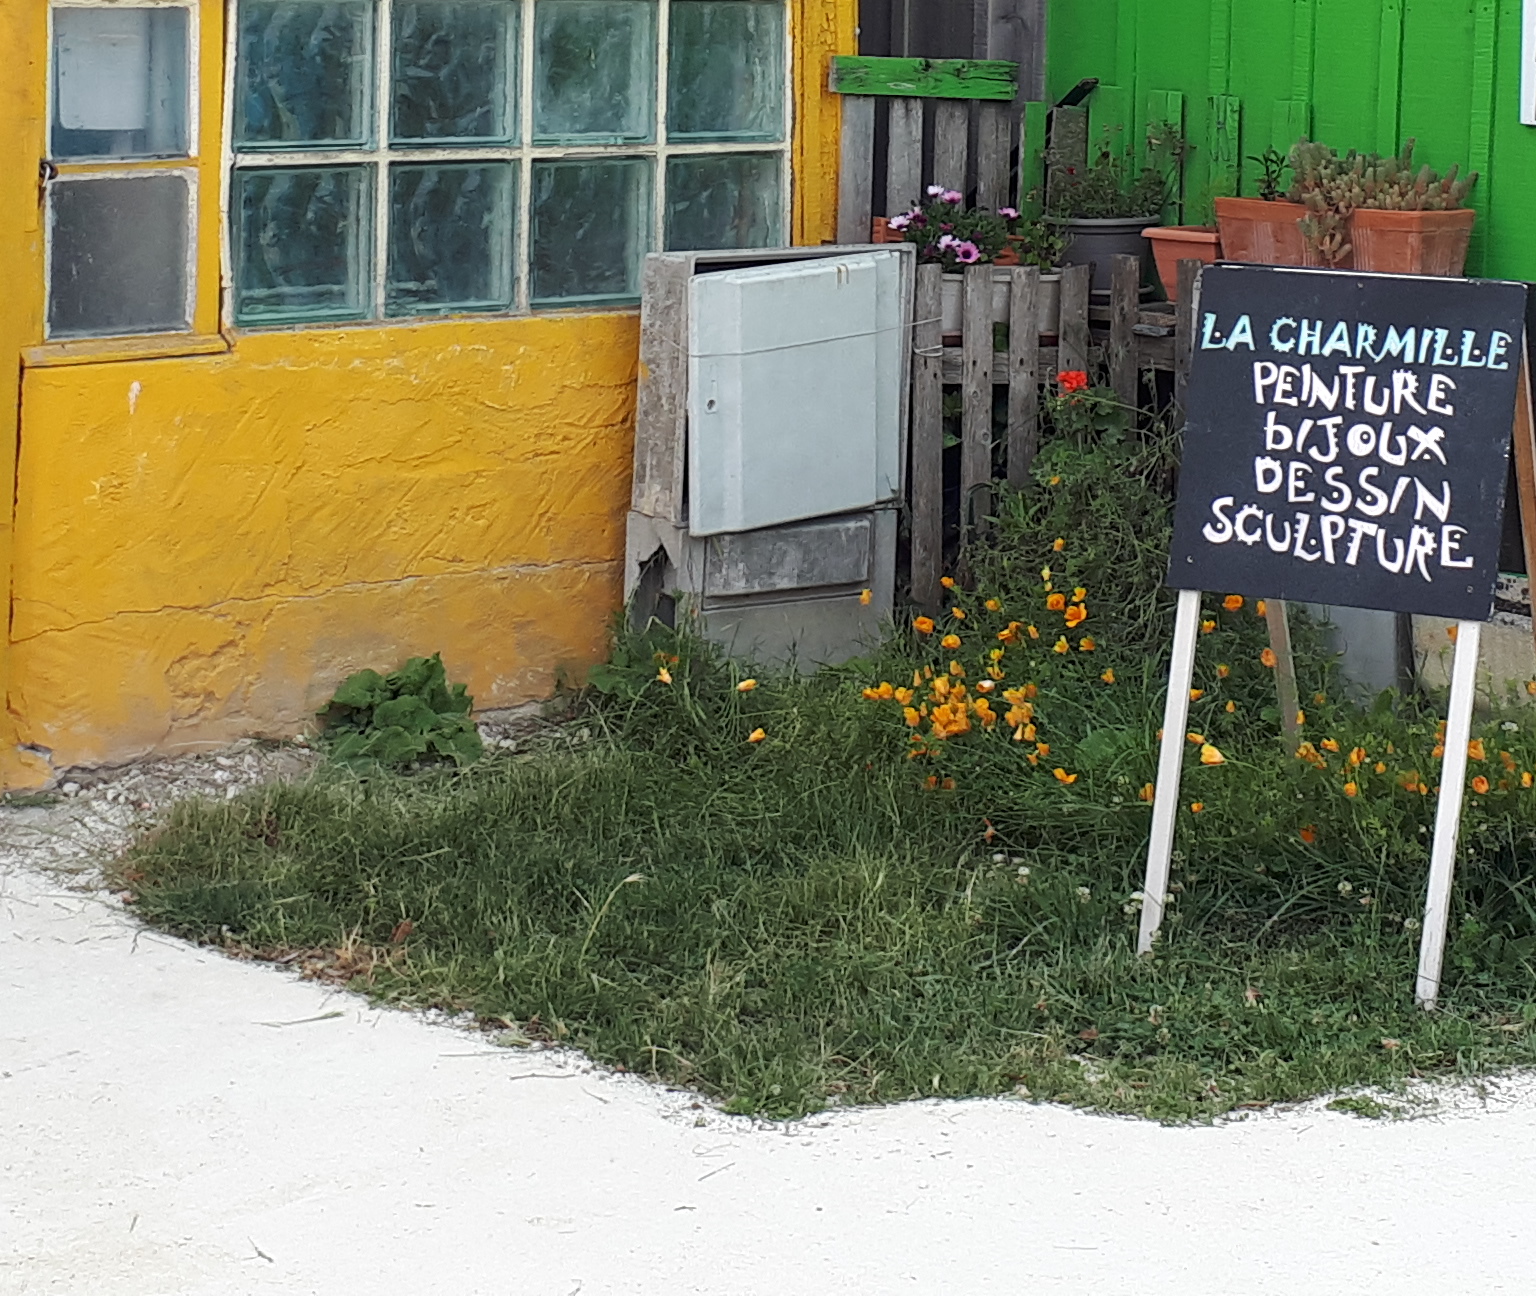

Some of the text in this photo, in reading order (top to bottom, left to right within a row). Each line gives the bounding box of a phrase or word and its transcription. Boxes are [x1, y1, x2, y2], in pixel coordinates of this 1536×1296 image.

[1200, 312, 1513, 370] LA CHARMILLE
[1253, 361, 1457, 416] PEINTURE
[1254, 456, 1451, 523] DESSIN
[1202, 496, 1473, 582] SCULPTURE
